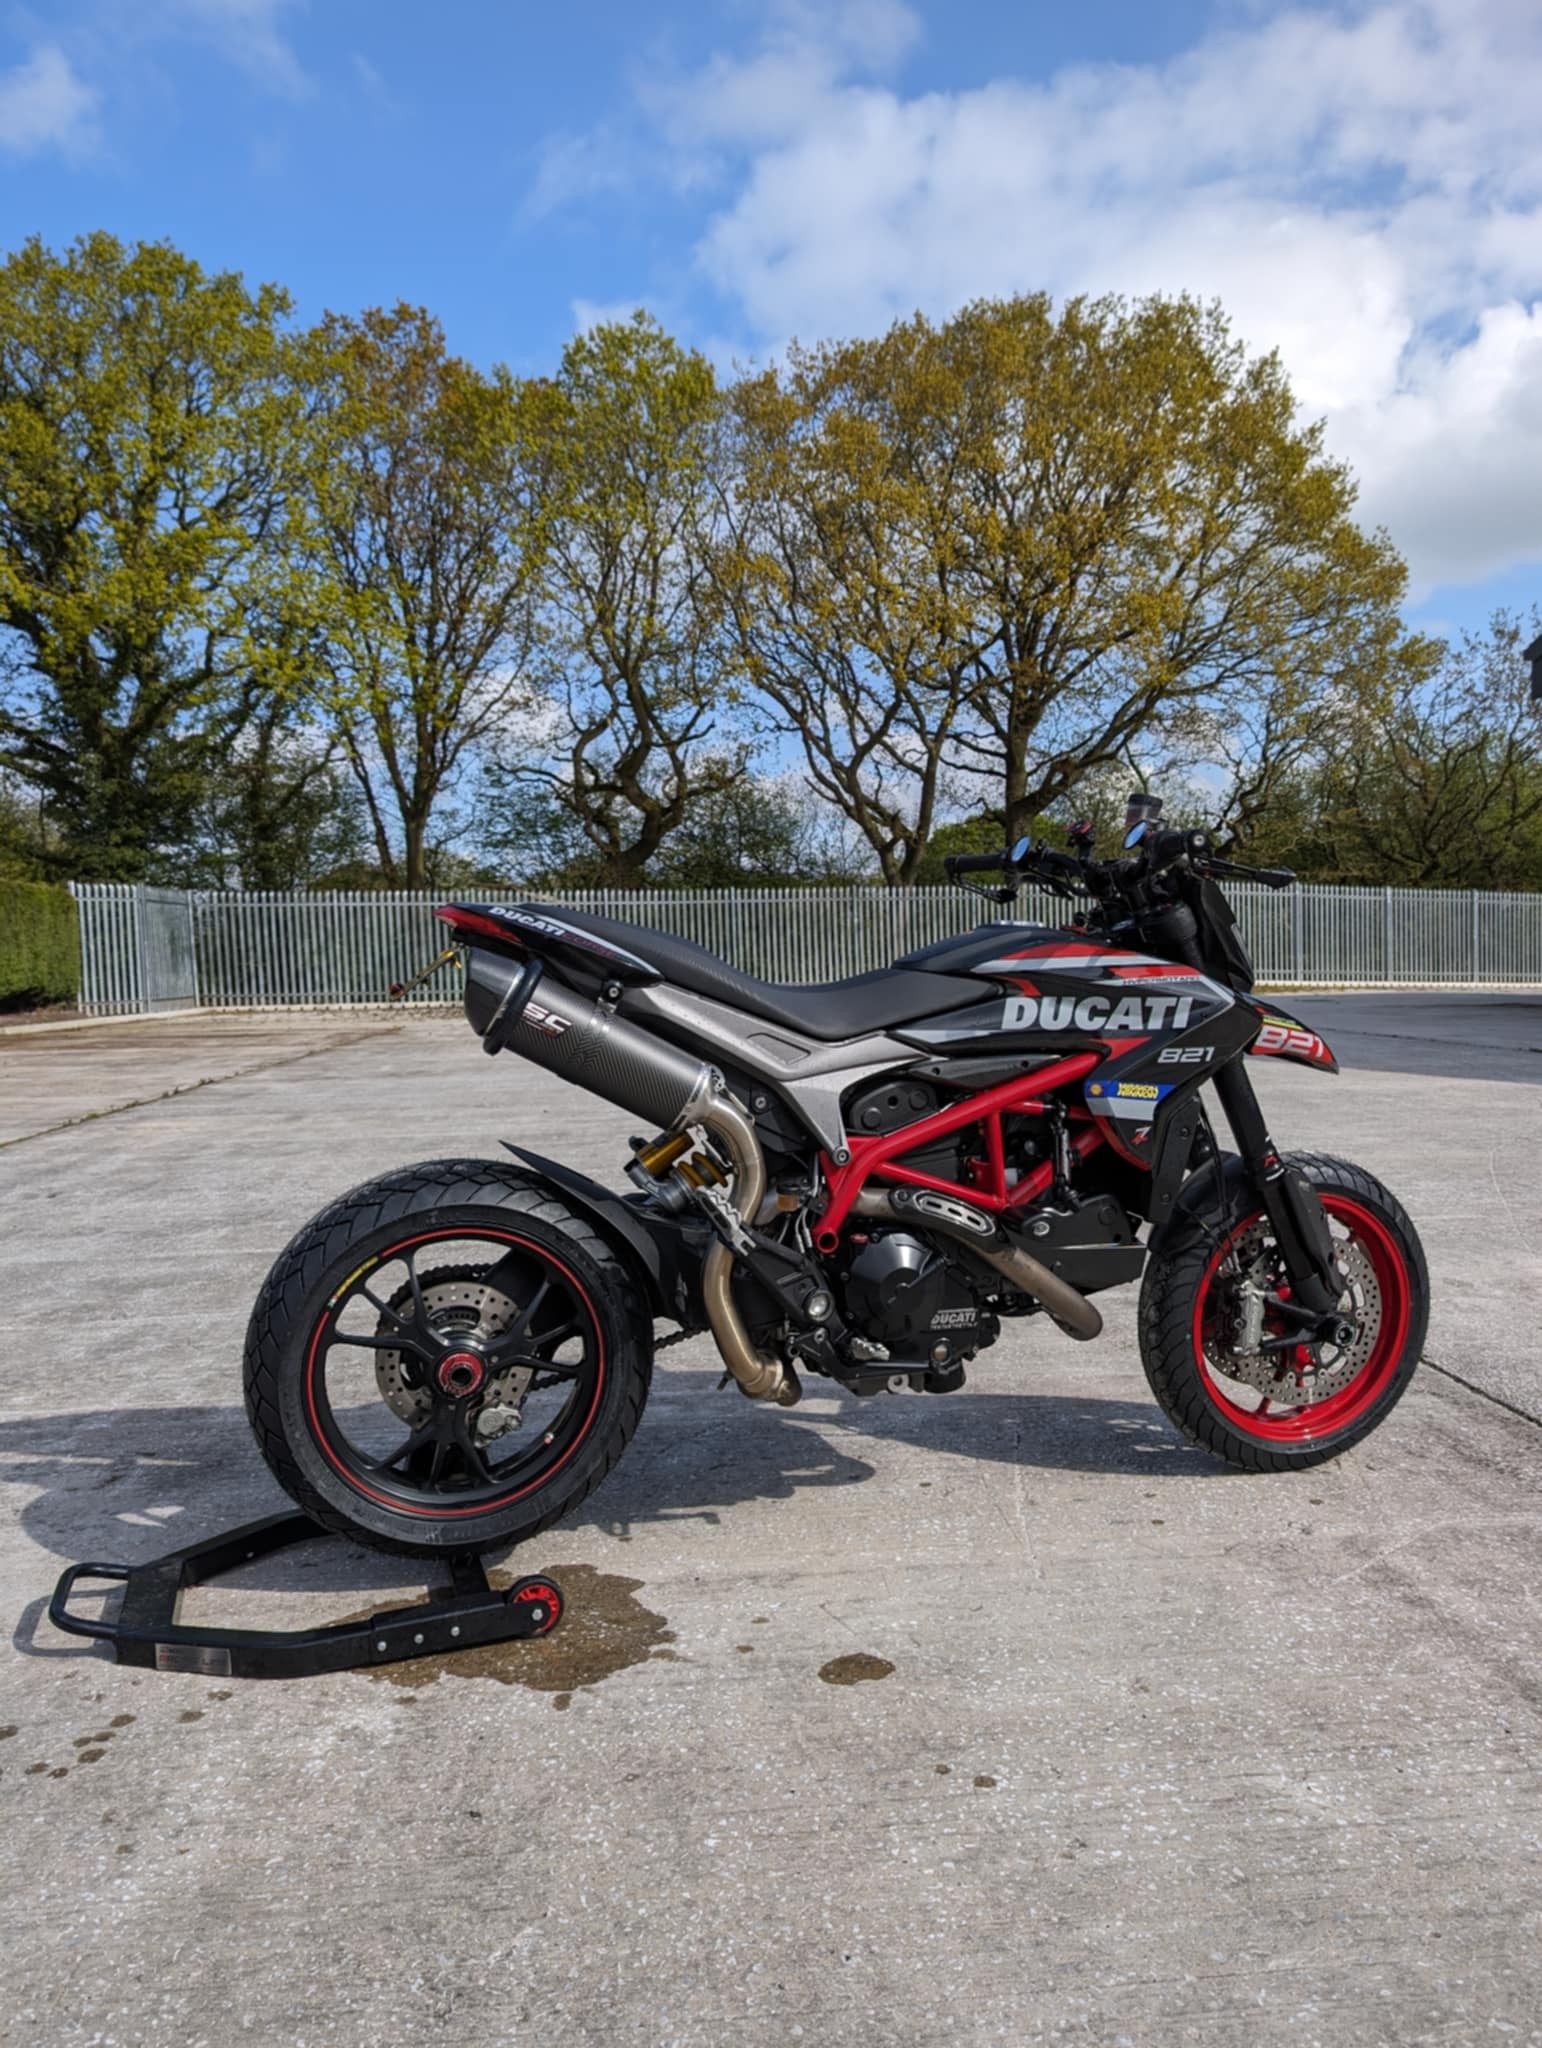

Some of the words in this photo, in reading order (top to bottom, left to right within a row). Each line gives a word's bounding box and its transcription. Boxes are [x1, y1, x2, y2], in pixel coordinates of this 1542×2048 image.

[488, 906, 565, 936] DUCATI
[1001, 996, 1194, 1031] DUCATI
[1157, 1046, 1215, 1063] 821
[1255, 1024, 1325, 1058] 821
[931, 1311, 976, 1325] DUCATI
